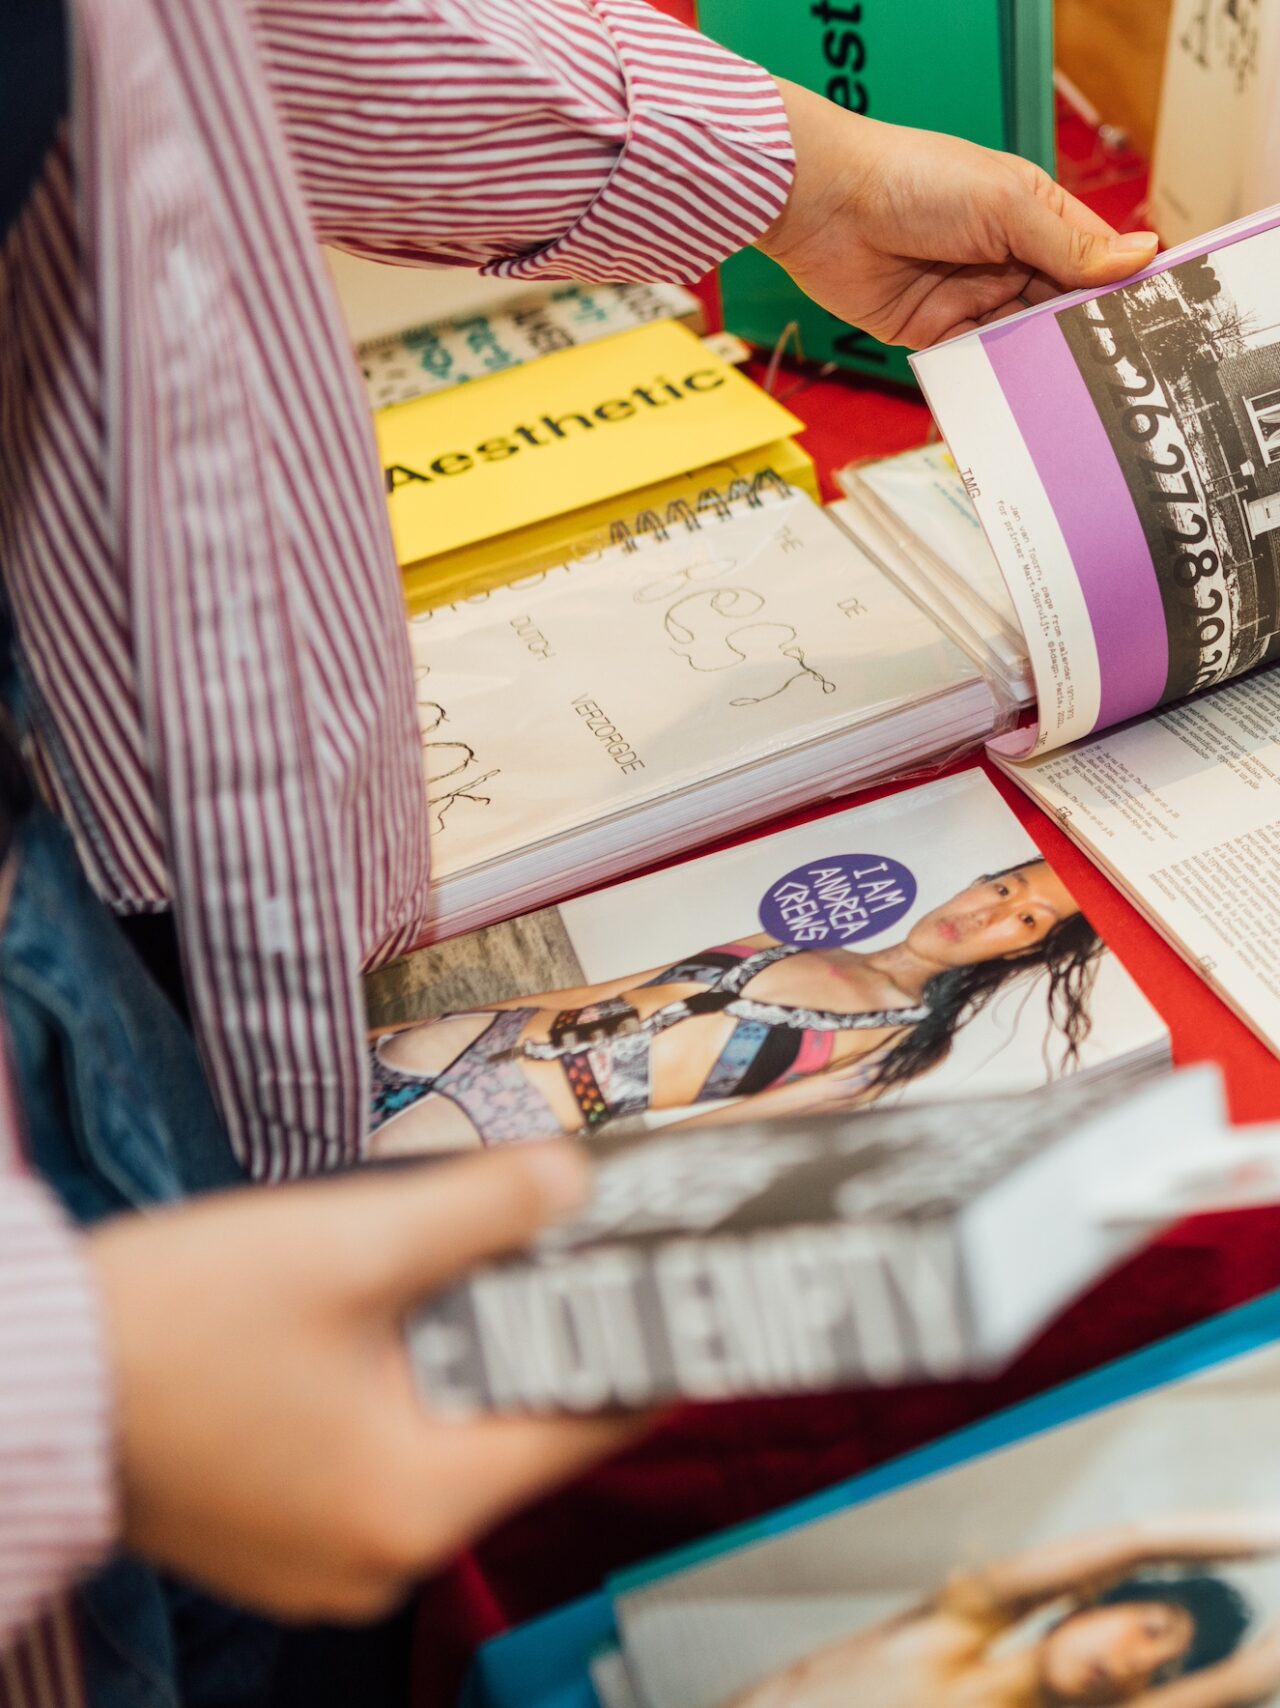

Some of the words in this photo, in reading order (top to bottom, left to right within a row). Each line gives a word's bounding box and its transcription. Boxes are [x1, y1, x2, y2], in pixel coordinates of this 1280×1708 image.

[386, 367, 728, 493] Aesthetic
[960, 467, 981, 500] TMG
[837, 596, 868, 619] DE
[509, 614, 557, 662] DUTCH
[570, 692, 646, 776] VERZORGDE
[853, 862, 888, 879] I
[773, 881, 830, 942] CREWS
[808, 867, 870, 940] ANDREA
[857, 879, 907, 914] AM
